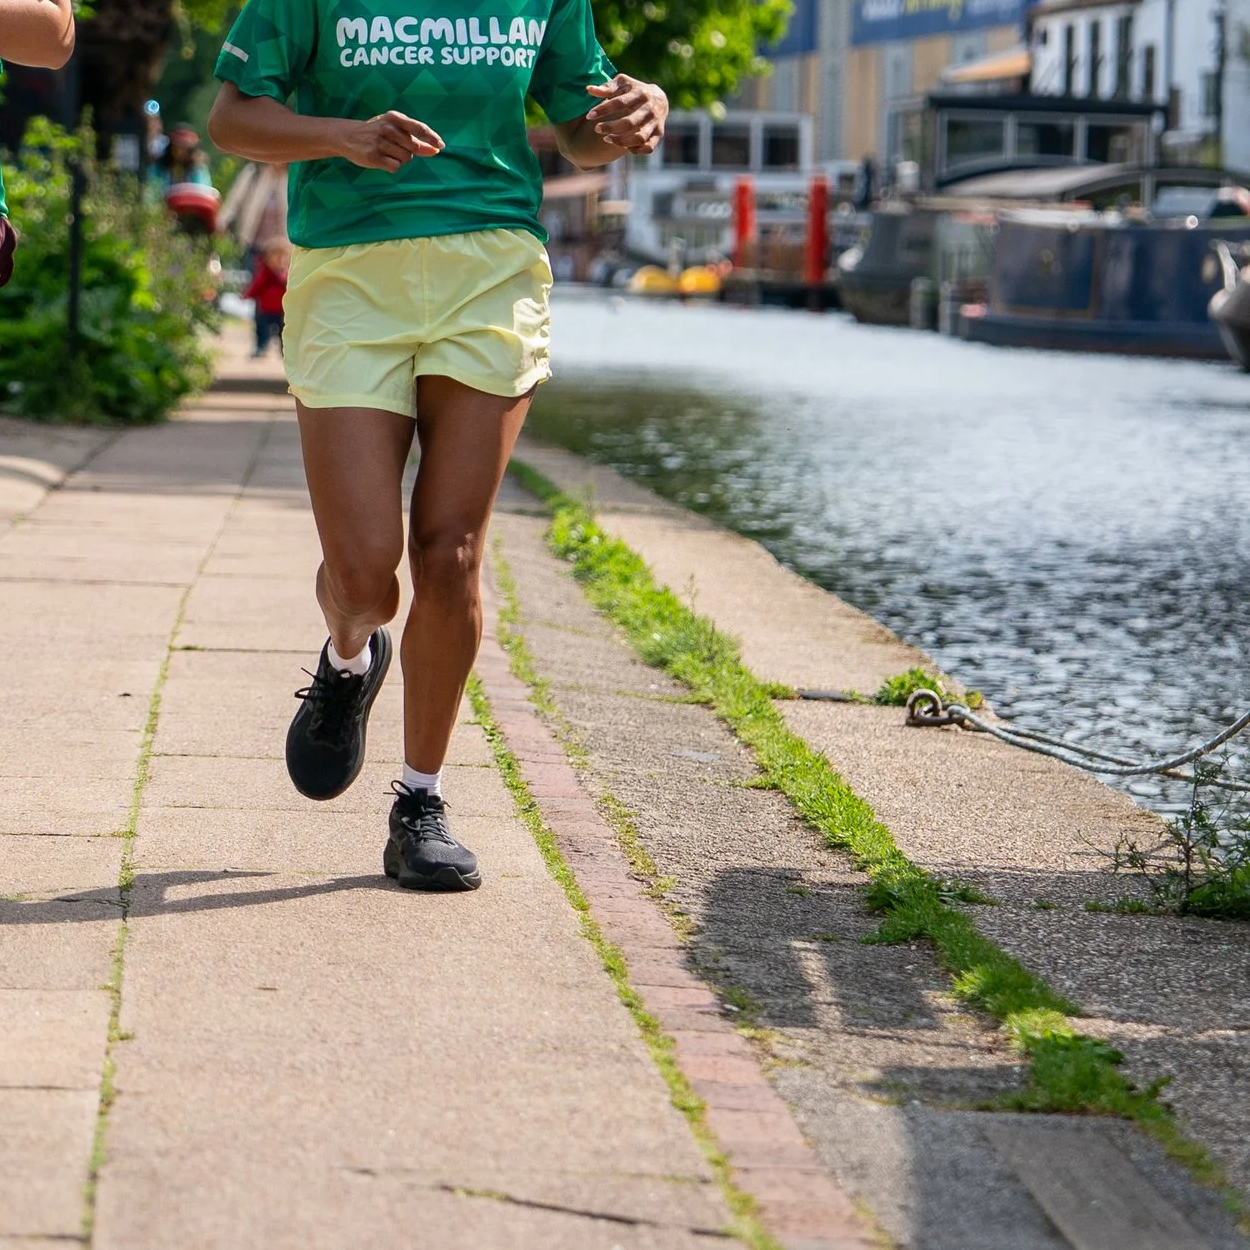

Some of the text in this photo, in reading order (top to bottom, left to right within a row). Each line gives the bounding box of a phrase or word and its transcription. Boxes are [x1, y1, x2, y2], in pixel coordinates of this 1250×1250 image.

[336, 16, 547, 48] MACMILLAN
[339, 45, 536, 70] CANCER SUPPORT
